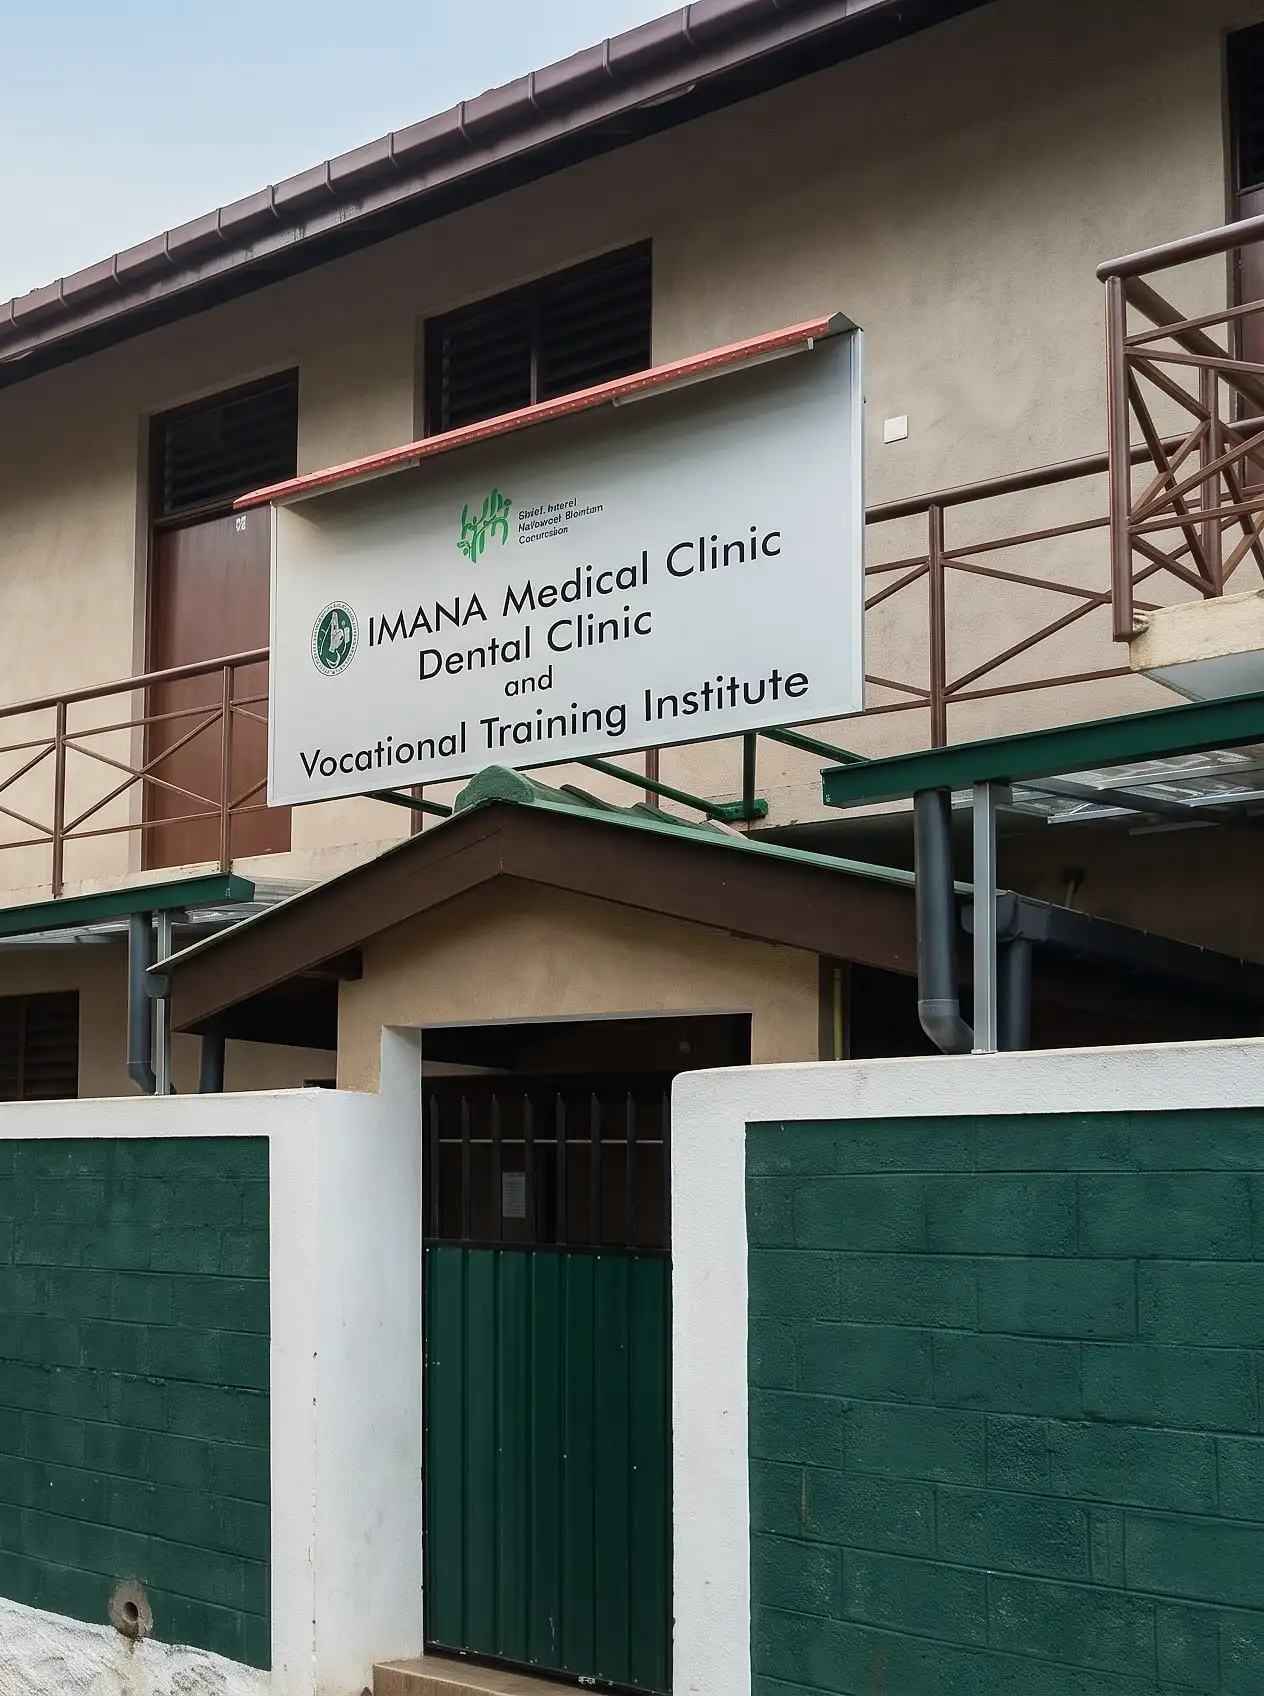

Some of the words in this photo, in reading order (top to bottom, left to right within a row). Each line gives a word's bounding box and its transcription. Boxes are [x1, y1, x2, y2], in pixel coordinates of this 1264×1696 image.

[369, 593, 488, 647] IMANA
[502, 550, 648, 617] Medical
[667, 527, 781, 577] Clinic
[419, 626, 531, 681] Dental
[547, 607, 652, 652] Clinic
[504, 665, 553, 697] and
[299, 722, 466, 779] Vocational
[479, 701, 626, 749] Training
[645, 668, 810, 722] Institute
